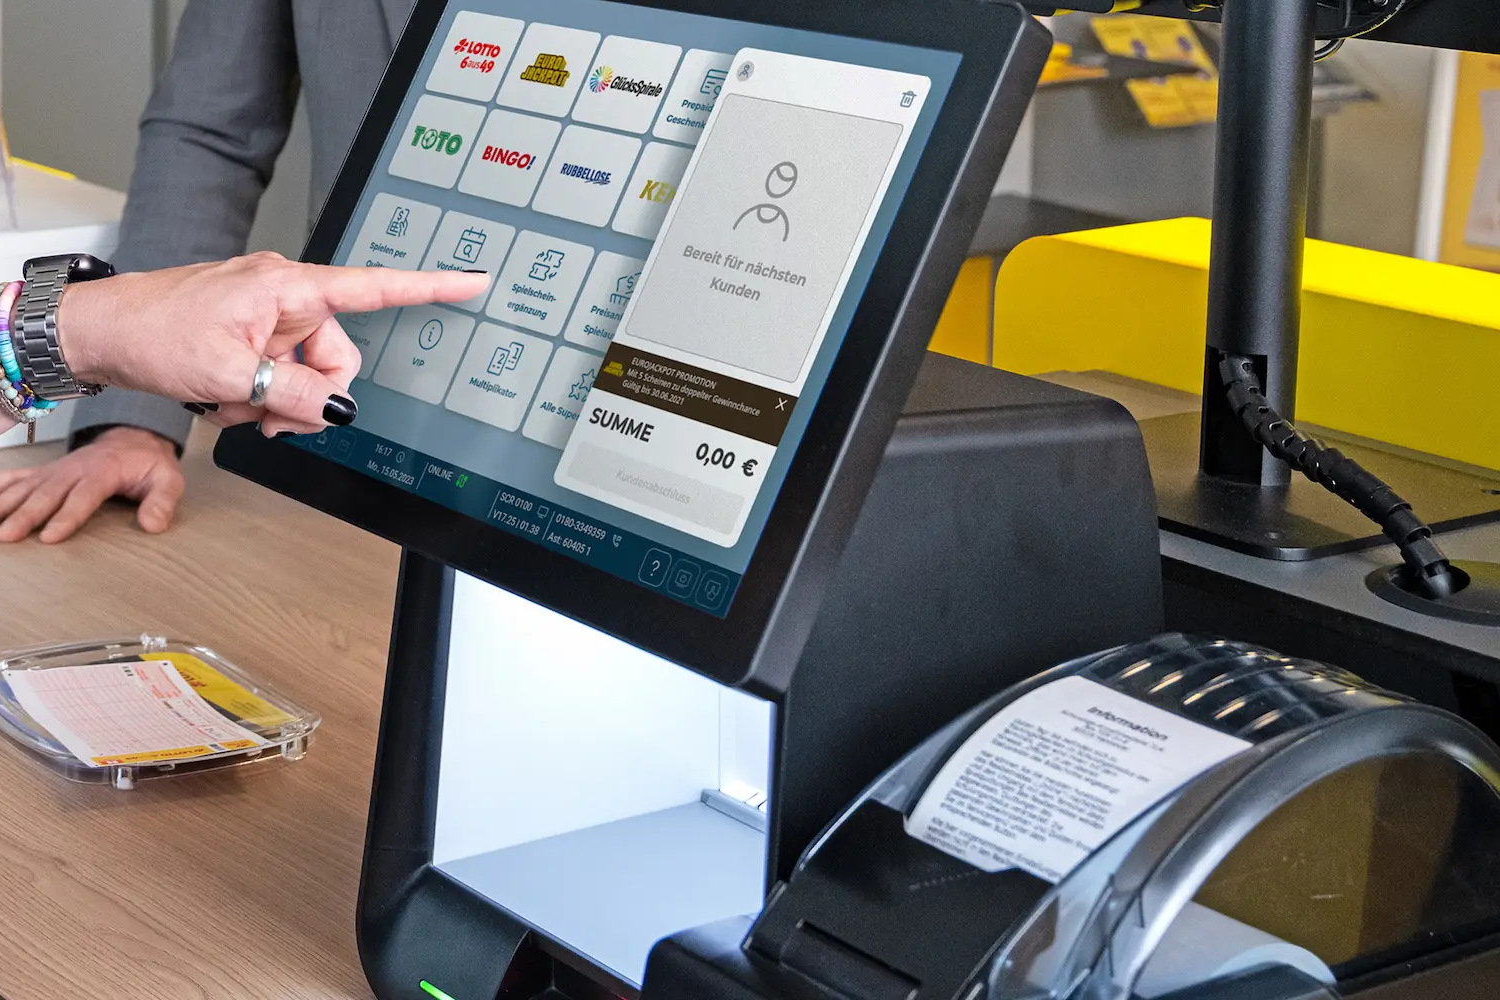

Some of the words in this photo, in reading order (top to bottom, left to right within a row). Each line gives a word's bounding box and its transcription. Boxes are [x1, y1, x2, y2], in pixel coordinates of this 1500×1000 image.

[467, 41, 501, 58] LOTTO
[535, 52, 566, 69] EURO
[520, 66, 570, 87] JACKPOT
[610, 75, 663, 98] GlücksSpirale
[681, 99, 715, 113] Prepaid
[411, 125, 463, 155] TOTO
[482, 145, 536, 171] BINGO!
[560, 163, 611, 184] RUBBELLOSE
[369, 241, 393, 256] Spielen
[394, 250, 407, 259] per
[683, 245, 722, 266] Bereit
[723, 254, 744, 271] für
[744, 262, 806, 287] nächsten
[511, 283, 557, 303] Spielschein-
[709, 277, 760, 301] Kunden
[507, 301, 547, 320] ergänzung
[412, 357, 425, 368] VIP
[631, 357, 676, 378] EUROJACKPOT
[676, 370, 717, 390] PROMOTION
[469, 377, 517, 400] Multiplikator
[622, 379, 641, 394] Gültig
[641, 384, 651, 394] bis
[650, 387, 684, 406] 30.06.2021
[627, 368, 639, 378] Mit
[643, 373, 672, 389] Scheinen
[671, 383, 680, 391] zu
[680, 384, 712, 403] doppelter
[712, 394, 761, 417] Gewinnchance
[540, 401, 556, 414] Alle
[589, 408, 655, 443] SUMME
[375, 443, 393, 457] 16:17
[696, 442, 736, 468] 0,00
[741, 458, 758, 477] €
[381, 465, 415, 486] 15.05.2023
[428, 464, 454, 482] ONLINE
[616, 469, 691, 504] Kundenabschluss
[500, 491, 515, 505] SCR
[515, 497, 534, 512] 0100
[555, 513, 607, 540] 0180-3349359
[562, 538, 586, 554] 60405
[1086, 706, 1168, 741] Information
